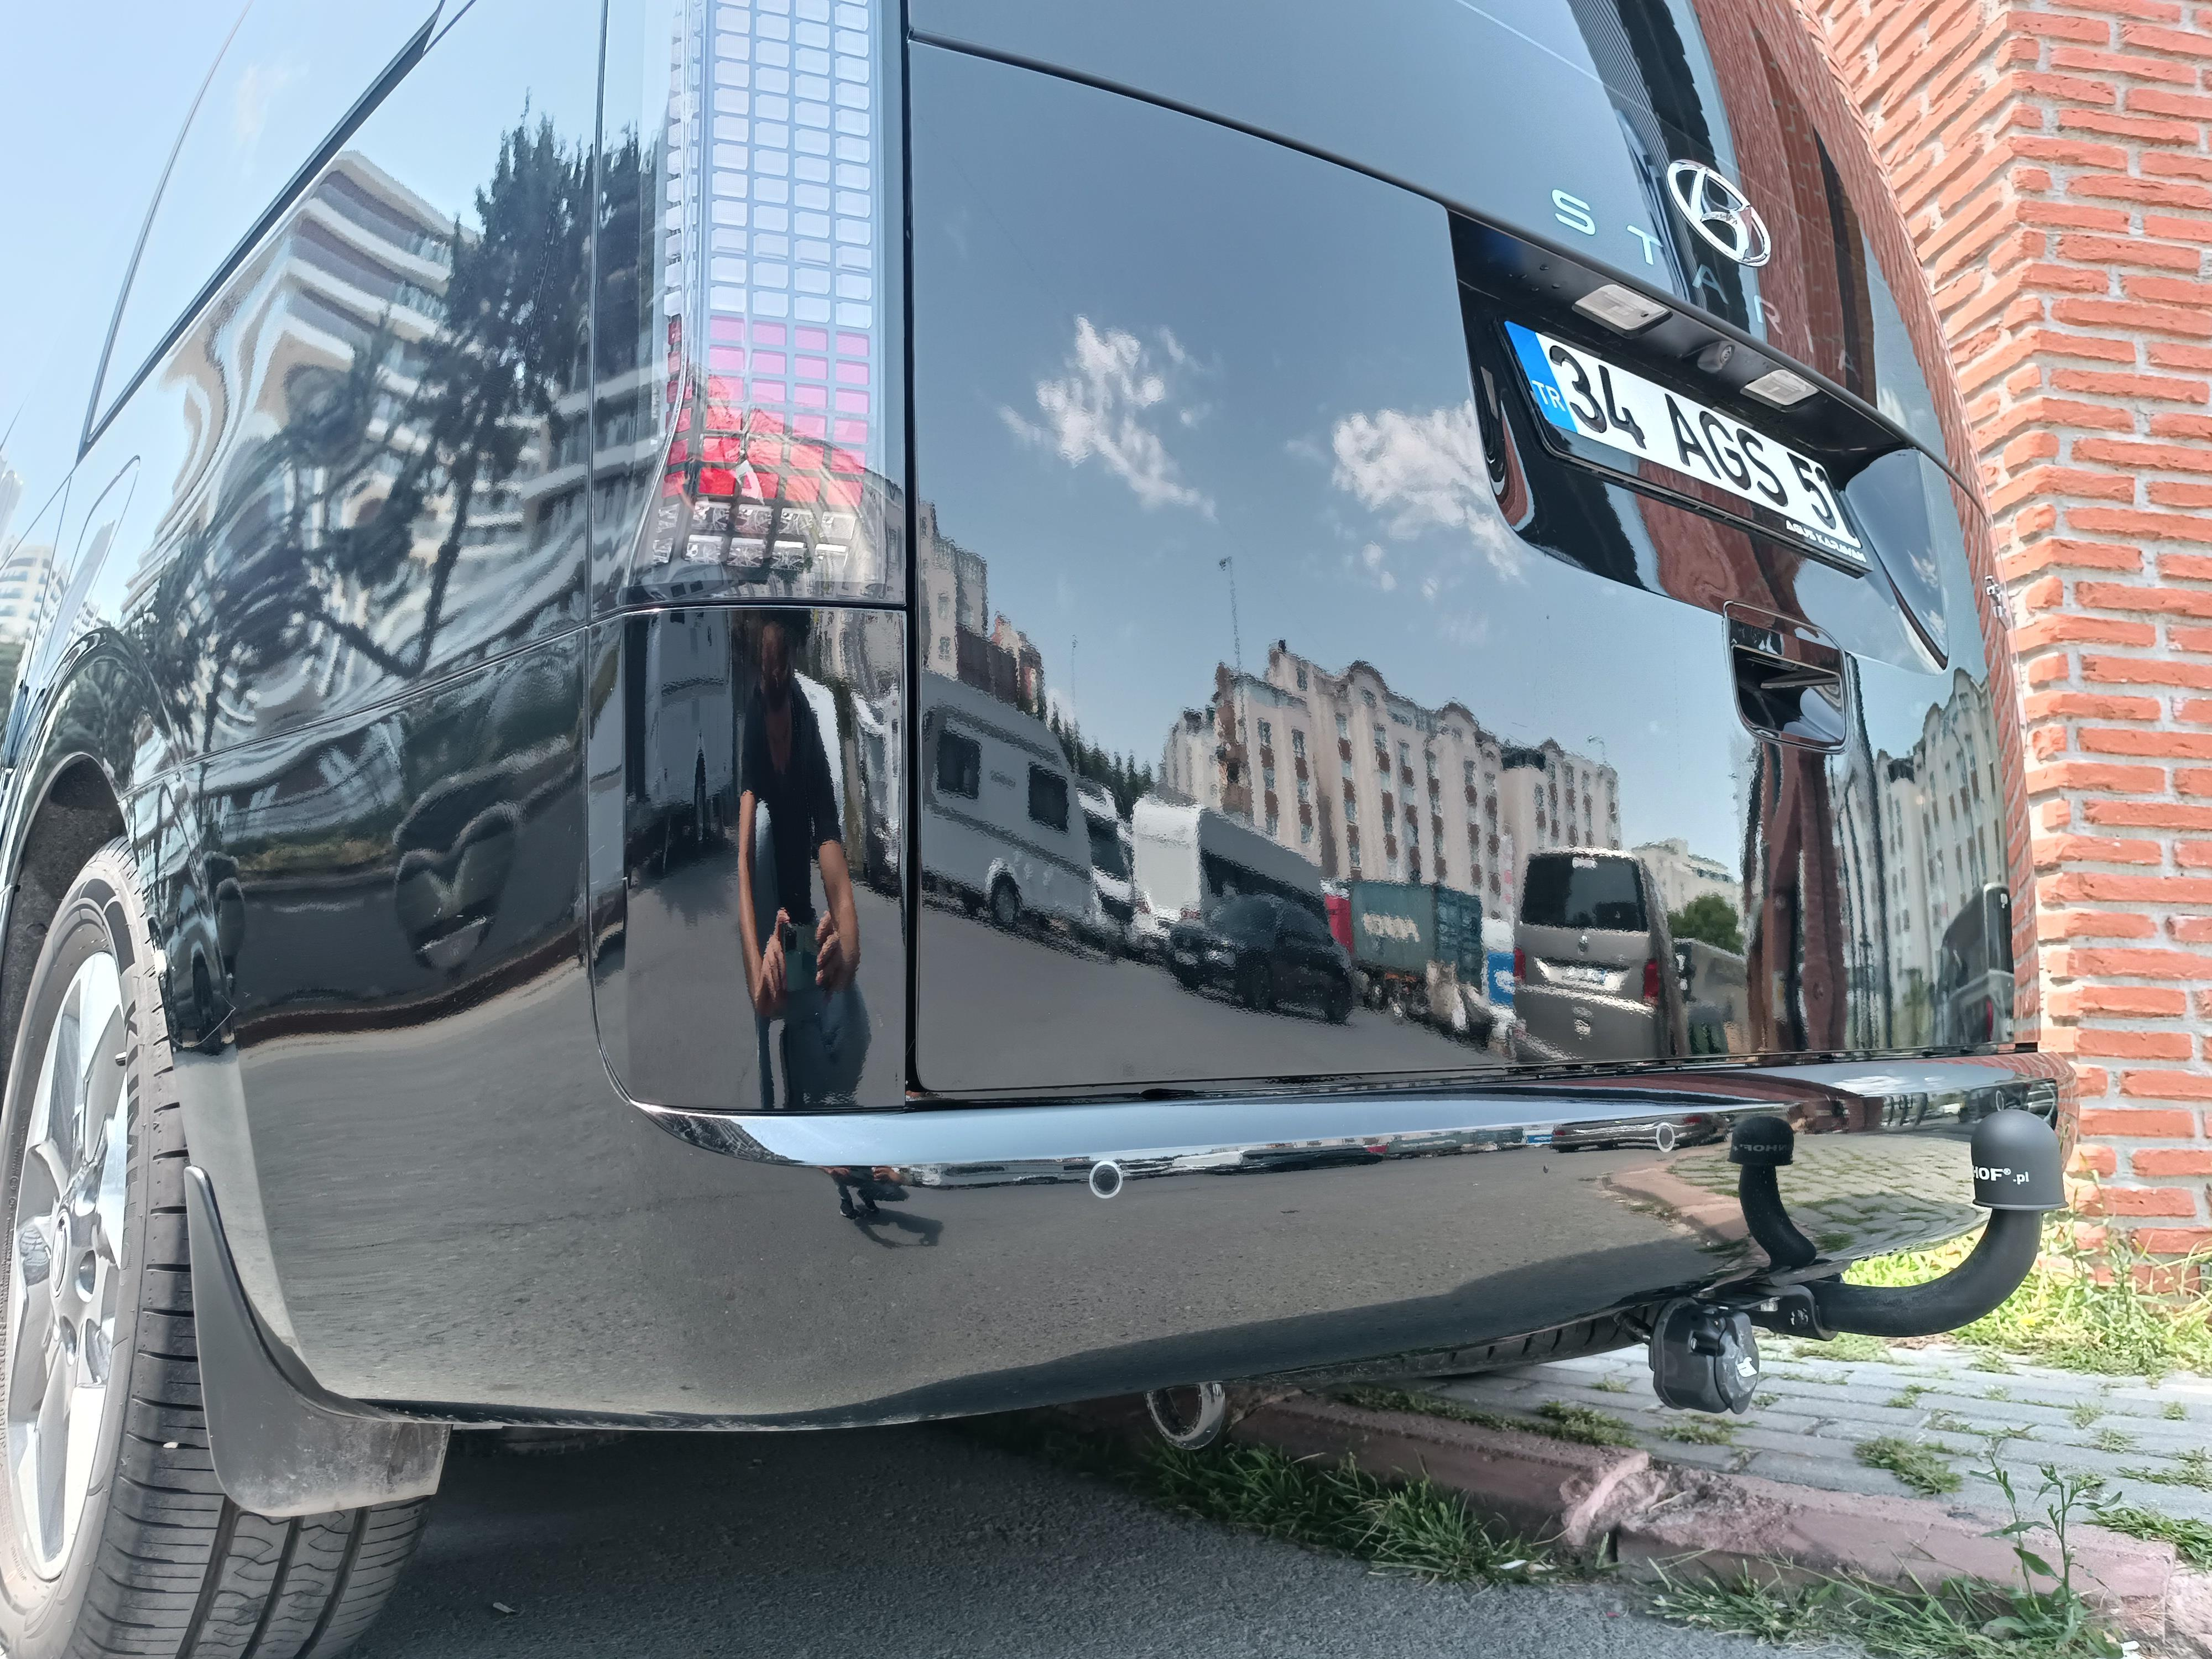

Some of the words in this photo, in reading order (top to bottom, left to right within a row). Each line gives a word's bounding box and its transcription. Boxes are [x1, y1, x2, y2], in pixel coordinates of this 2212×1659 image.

[1551, 189, 1861, 382] STARIA
[1532, 379, 1566, 411] TR
[1549, 345, 1647, 450] 34
[1664, 393, 1788, 507] AGS
